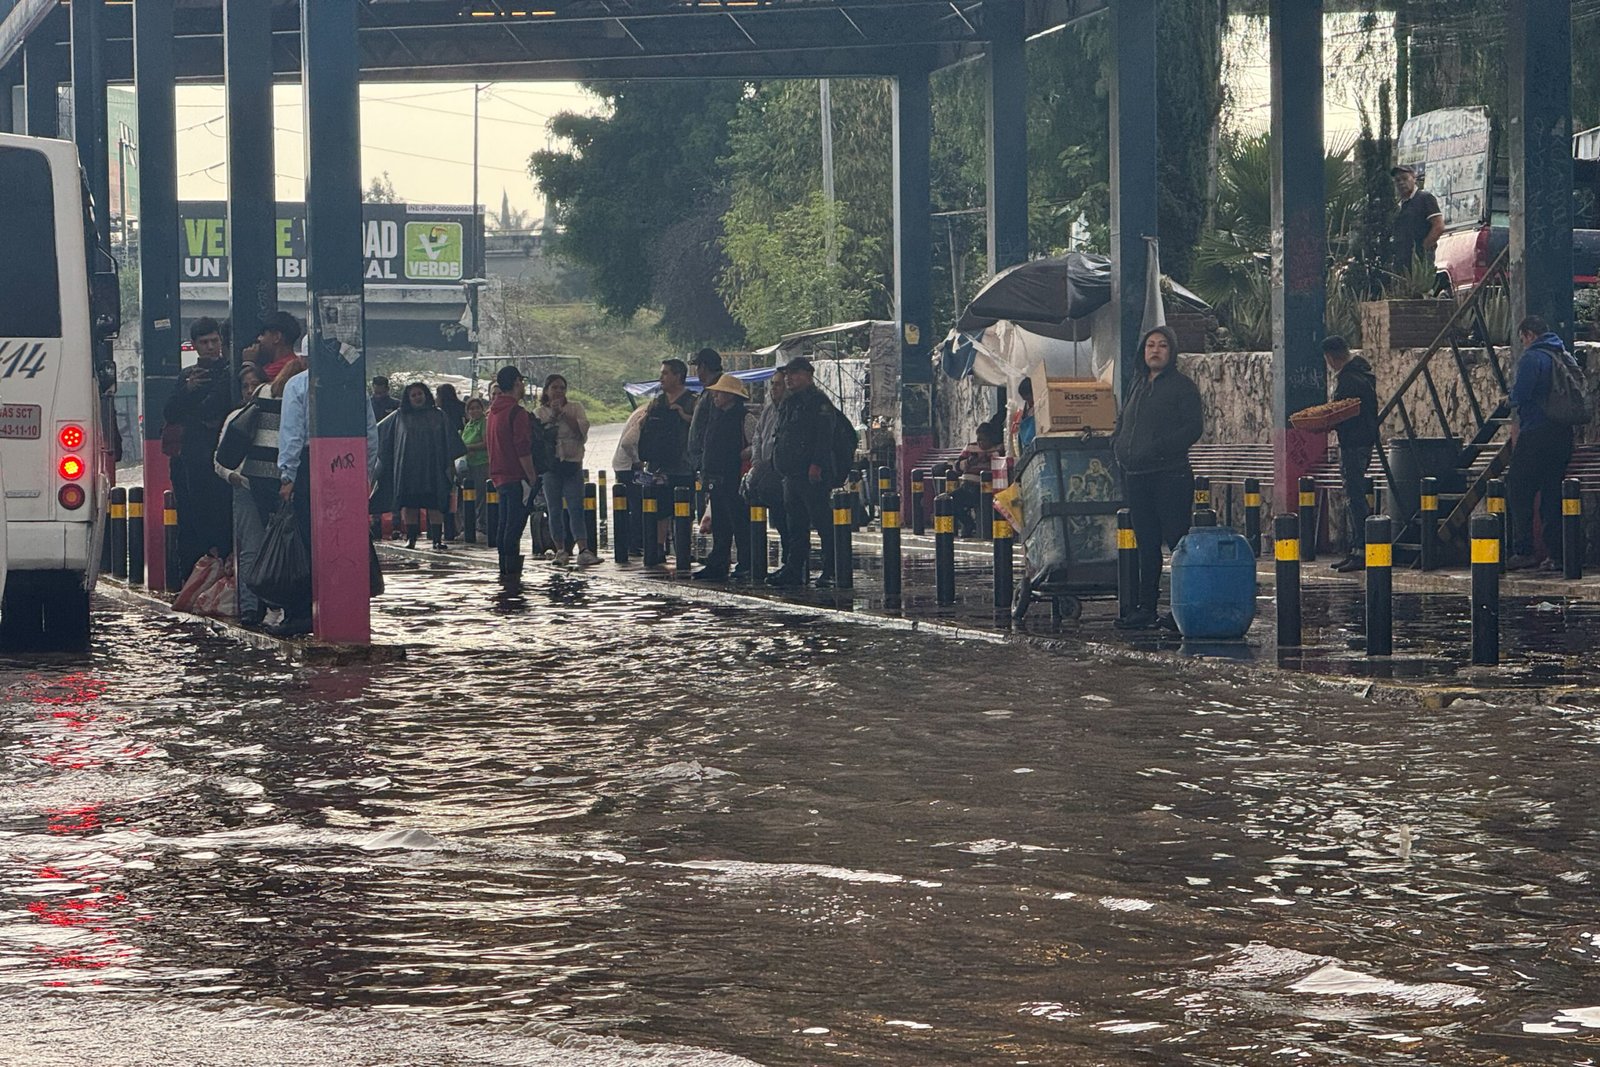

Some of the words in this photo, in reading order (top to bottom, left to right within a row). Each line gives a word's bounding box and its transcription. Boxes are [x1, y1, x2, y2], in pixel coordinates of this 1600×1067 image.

[184, 257, 220, 277] UN
[408, 261, 459, 276] VERDE
[16, 408, 32, 418] SCT
